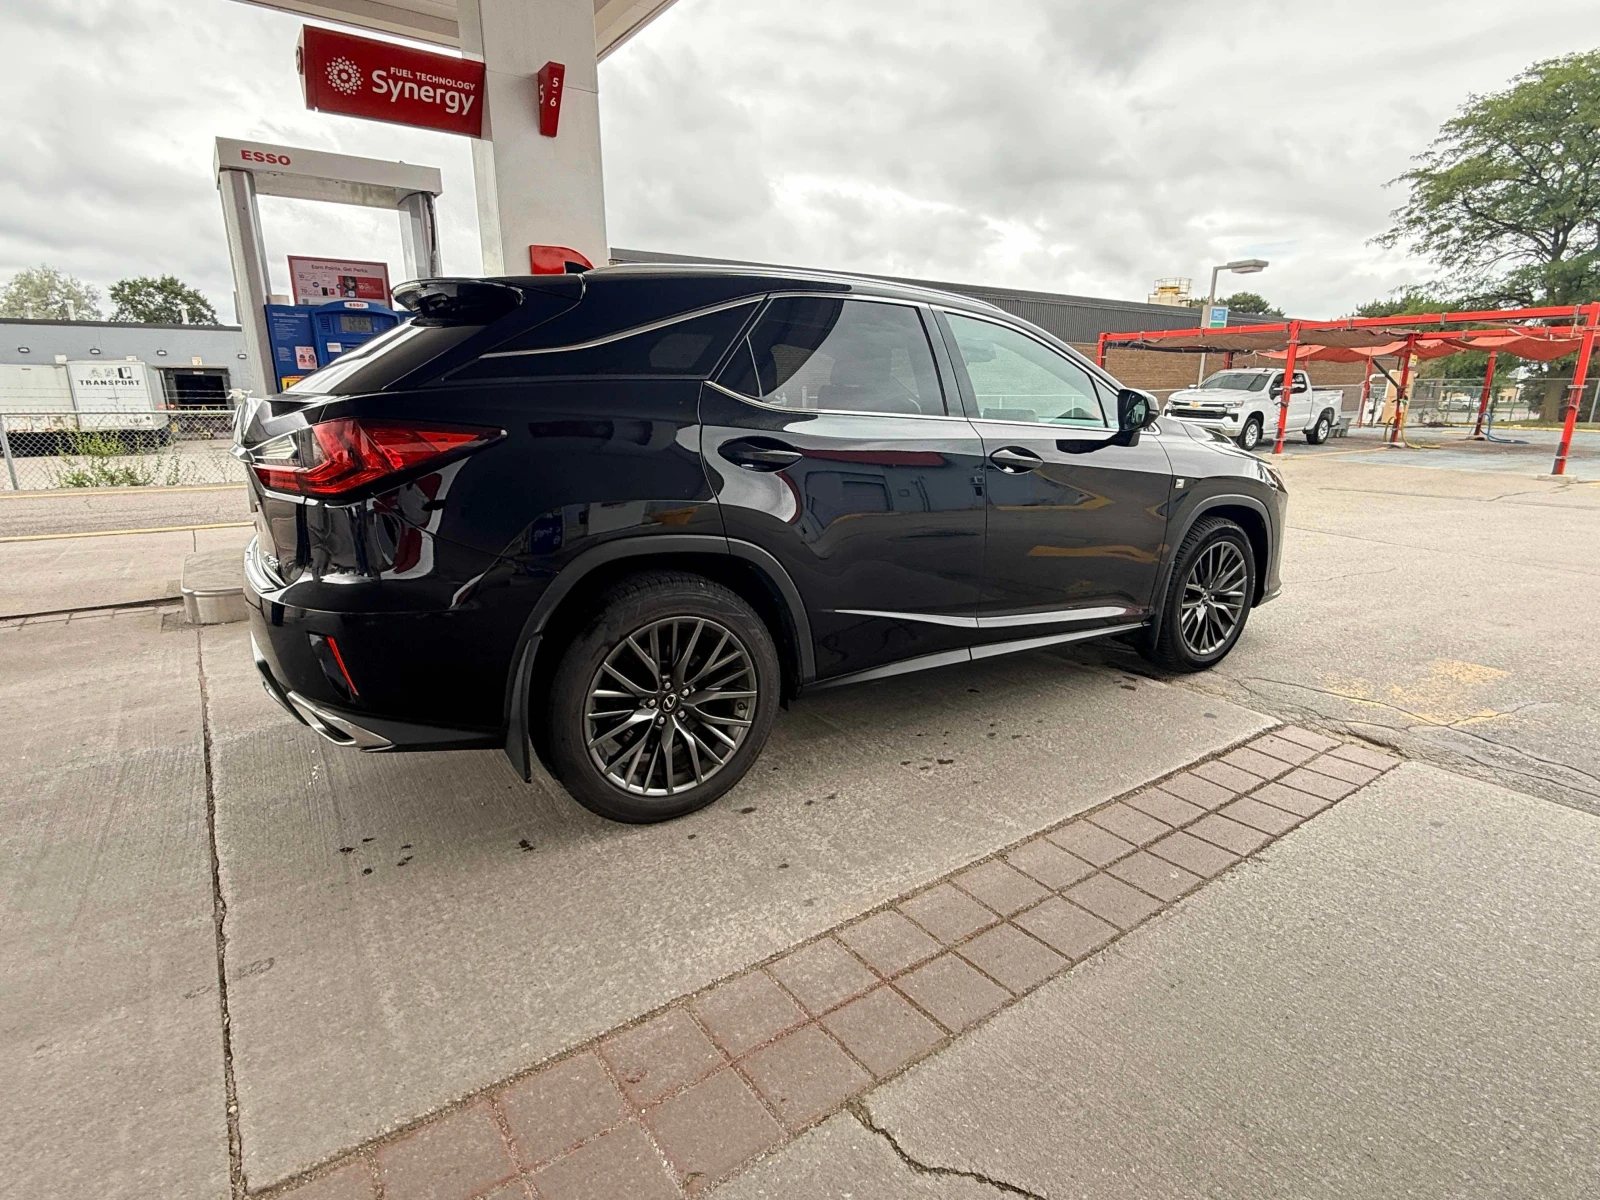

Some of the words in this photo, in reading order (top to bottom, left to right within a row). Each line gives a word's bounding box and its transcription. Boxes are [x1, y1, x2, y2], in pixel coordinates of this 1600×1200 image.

[390, 66, 413, 79] FUEL
[415, 71, 475, 91] TECHNOLOGY
[552, 77, 559, 88] 5
[371, 69, 475, 116] Synergy
[549, 97, 557, 107] 6
[240, 149, 291, 166] ESSO
